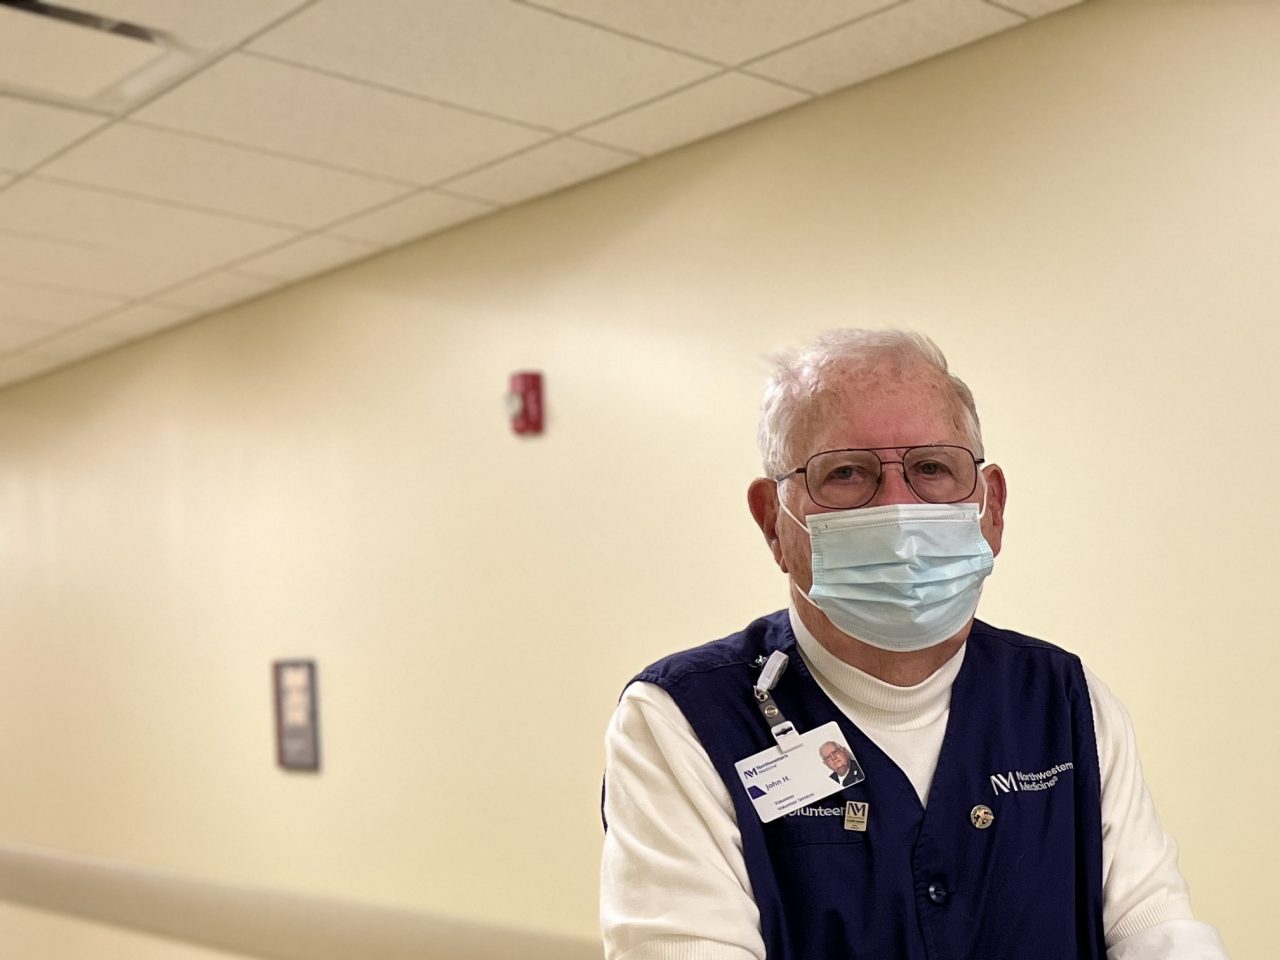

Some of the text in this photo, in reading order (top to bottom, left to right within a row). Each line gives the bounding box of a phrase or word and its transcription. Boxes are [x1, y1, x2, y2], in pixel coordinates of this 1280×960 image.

[1015, 761, 1074, 781] Northwestern
[765, 779, 782, 791] John
[783, 806, 846, 818] olunteer
